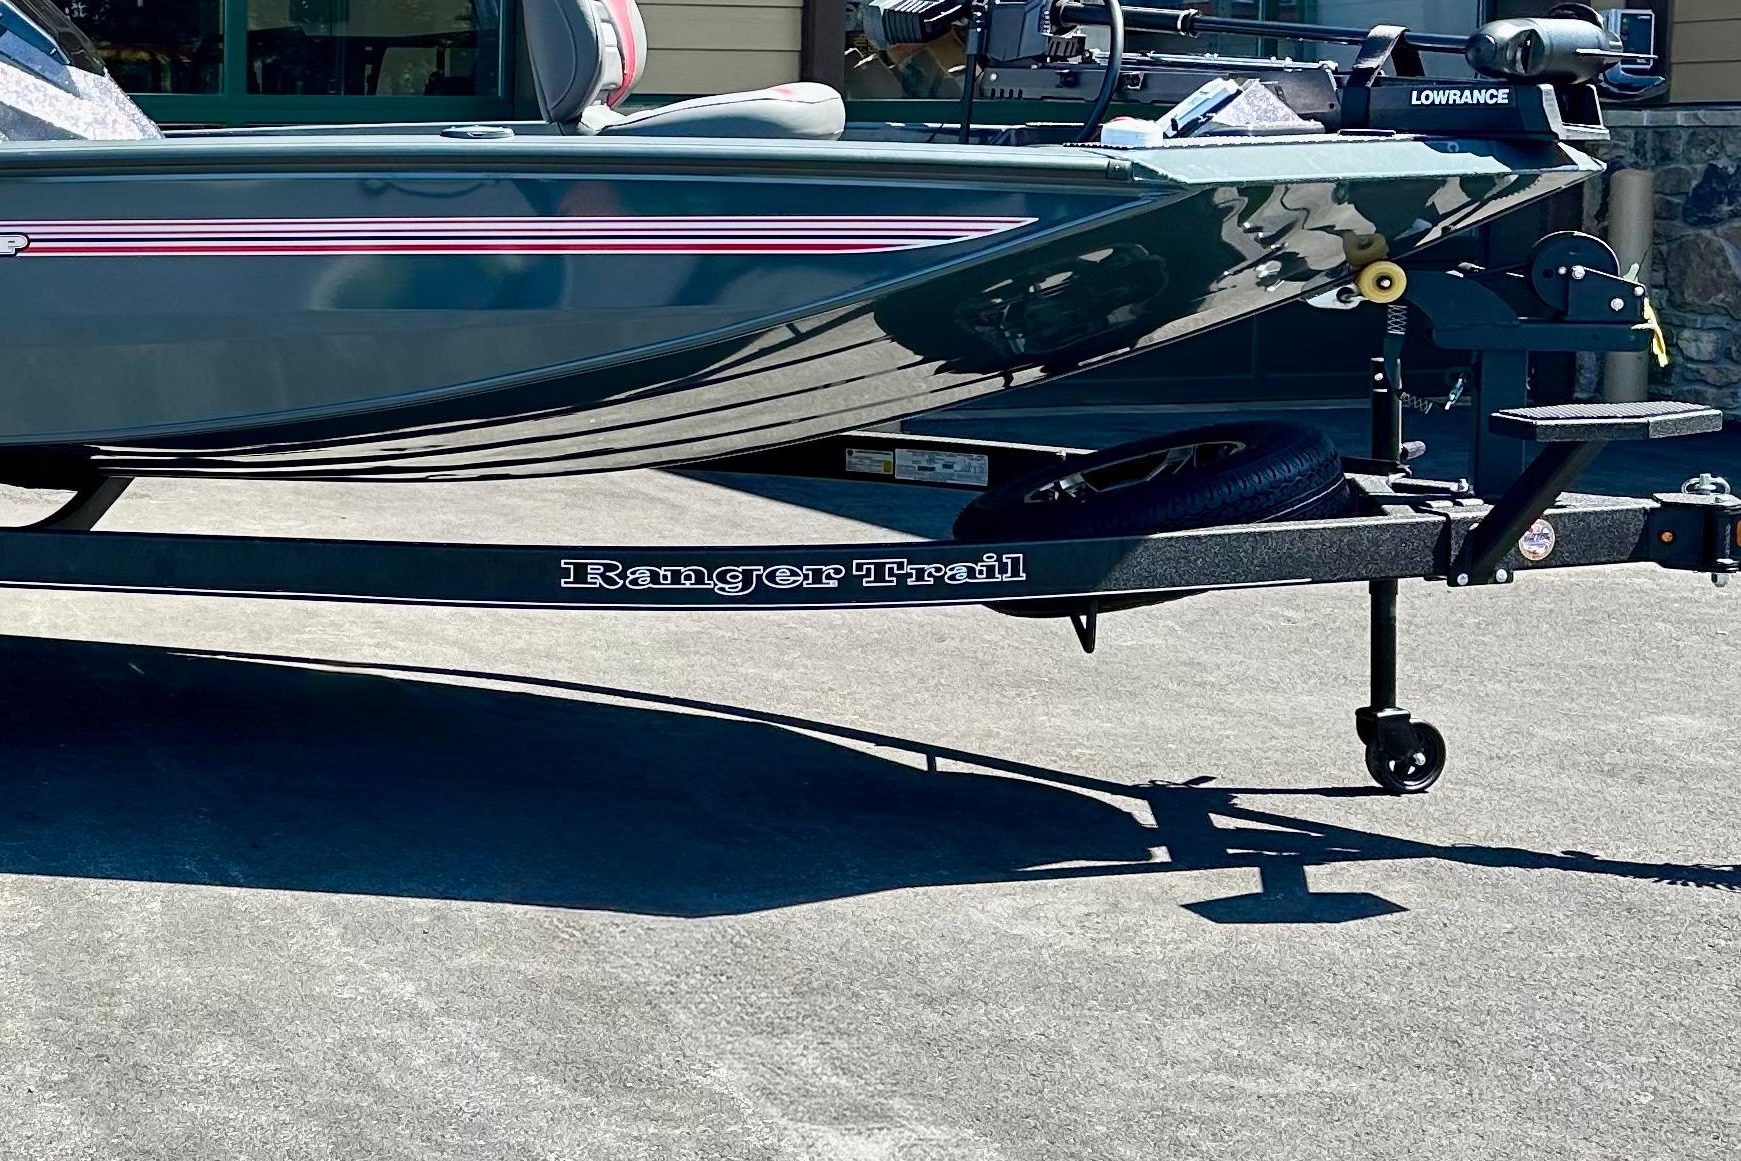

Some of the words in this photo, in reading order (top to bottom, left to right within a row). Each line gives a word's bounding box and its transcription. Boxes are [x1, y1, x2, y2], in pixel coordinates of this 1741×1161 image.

[1411, 88, 1509, 105] LOWRANCE
[560, 558, 845, 596] Ranger
[852, 553, 1027, 586] Trail
